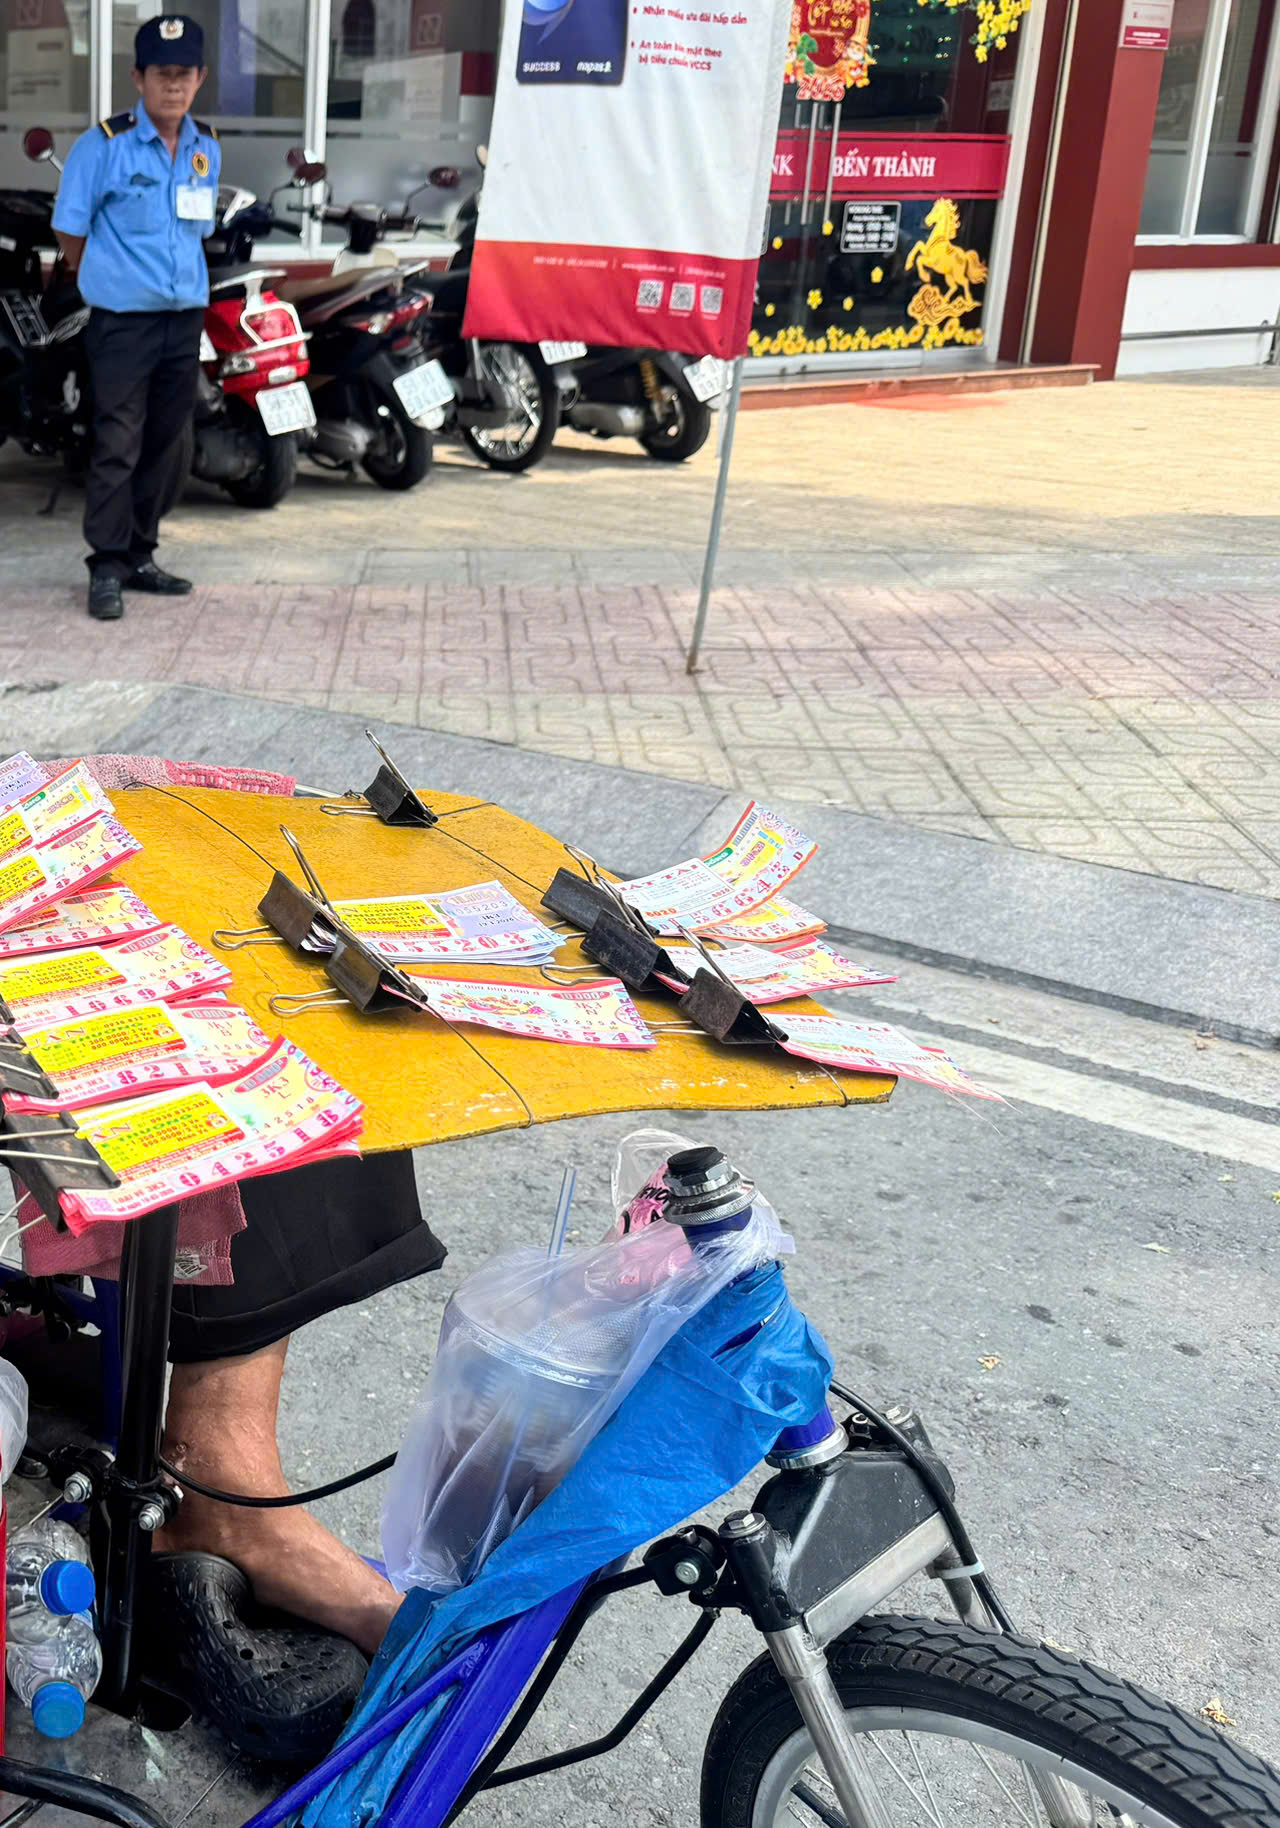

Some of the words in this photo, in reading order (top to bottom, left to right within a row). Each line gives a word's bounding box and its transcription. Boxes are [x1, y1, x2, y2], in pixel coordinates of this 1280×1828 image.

[523, 61, 561, 73] SUCCESS
[832, 147, 870, 177] BẾN
[873, 150, 937, 177] THÀNH
